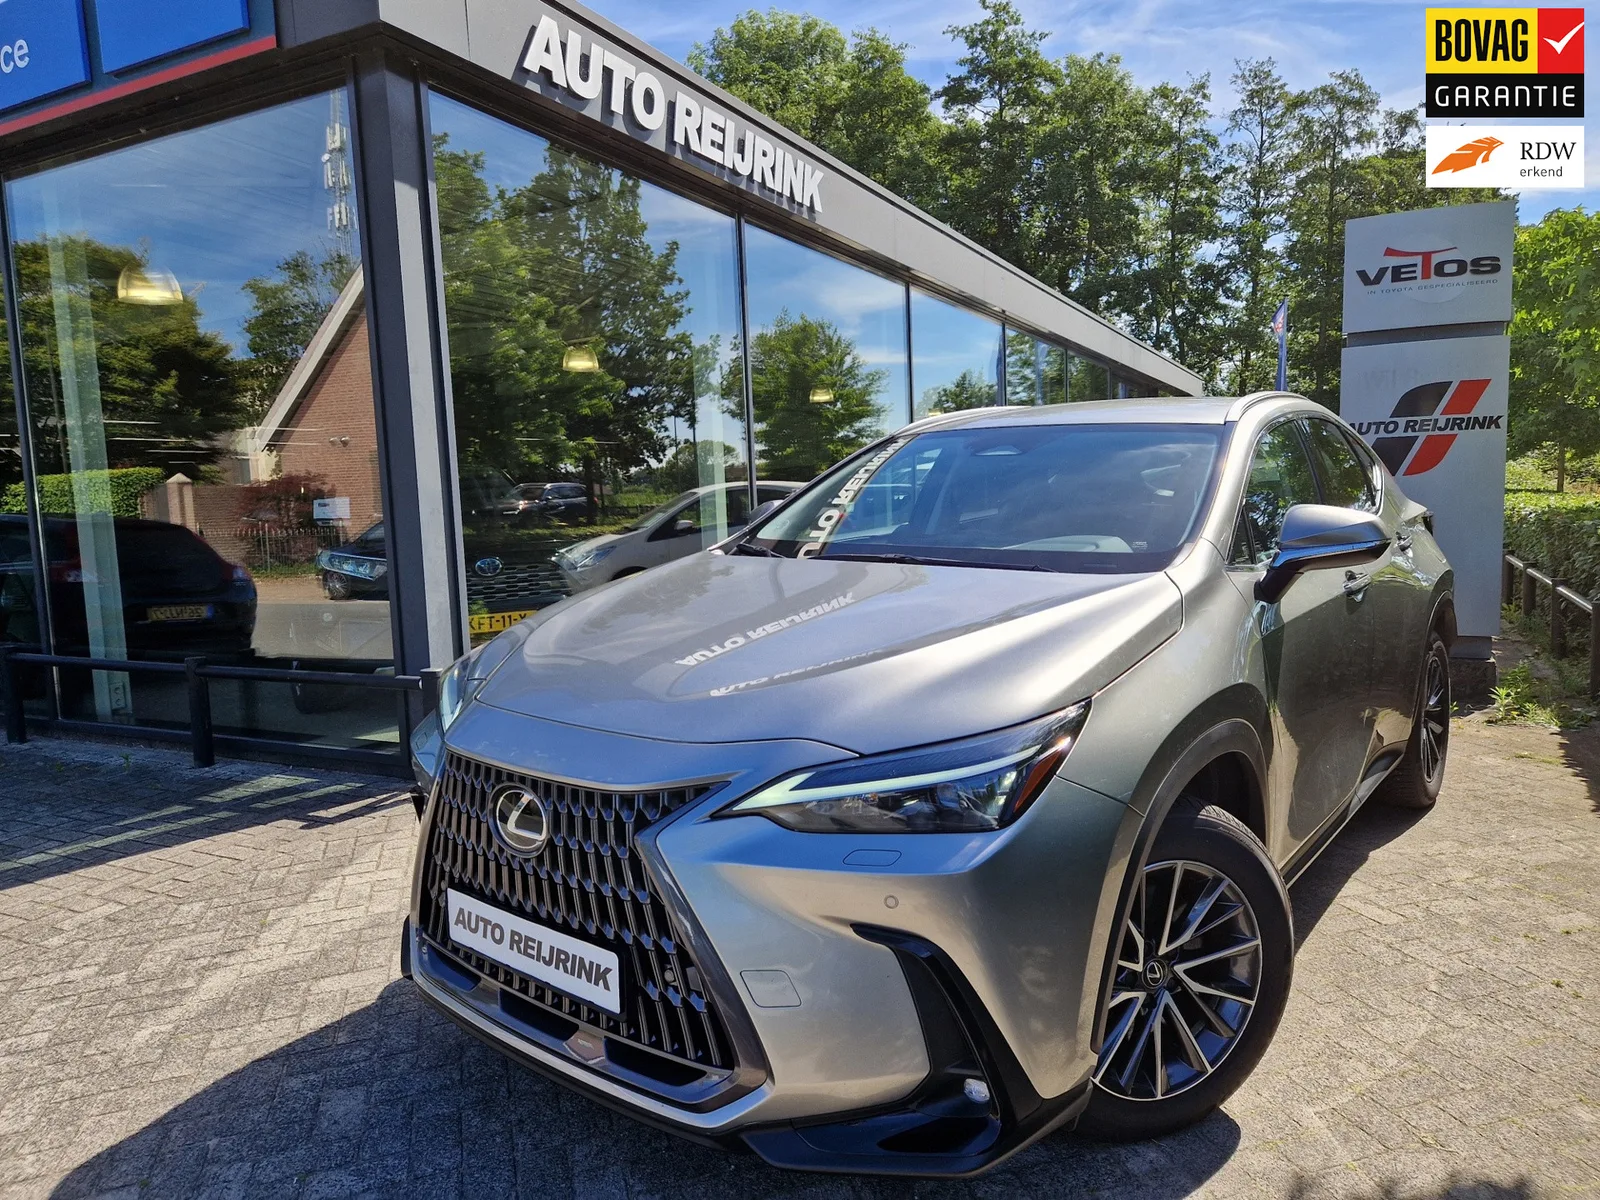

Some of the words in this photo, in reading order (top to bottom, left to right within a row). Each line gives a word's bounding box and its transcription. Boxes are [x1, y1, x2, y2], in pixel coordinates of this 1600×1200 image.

[523, 14, 666, 130] AUTO
[674, 91, 824, 212] REIJRINK
[1355, 247, 1502, 286] VETOS
[1403, 415, 1504, 433] REIJRINK
[454, 907, 505, 945] AUTO
[508, 929, 613, 992] REIJRINK
